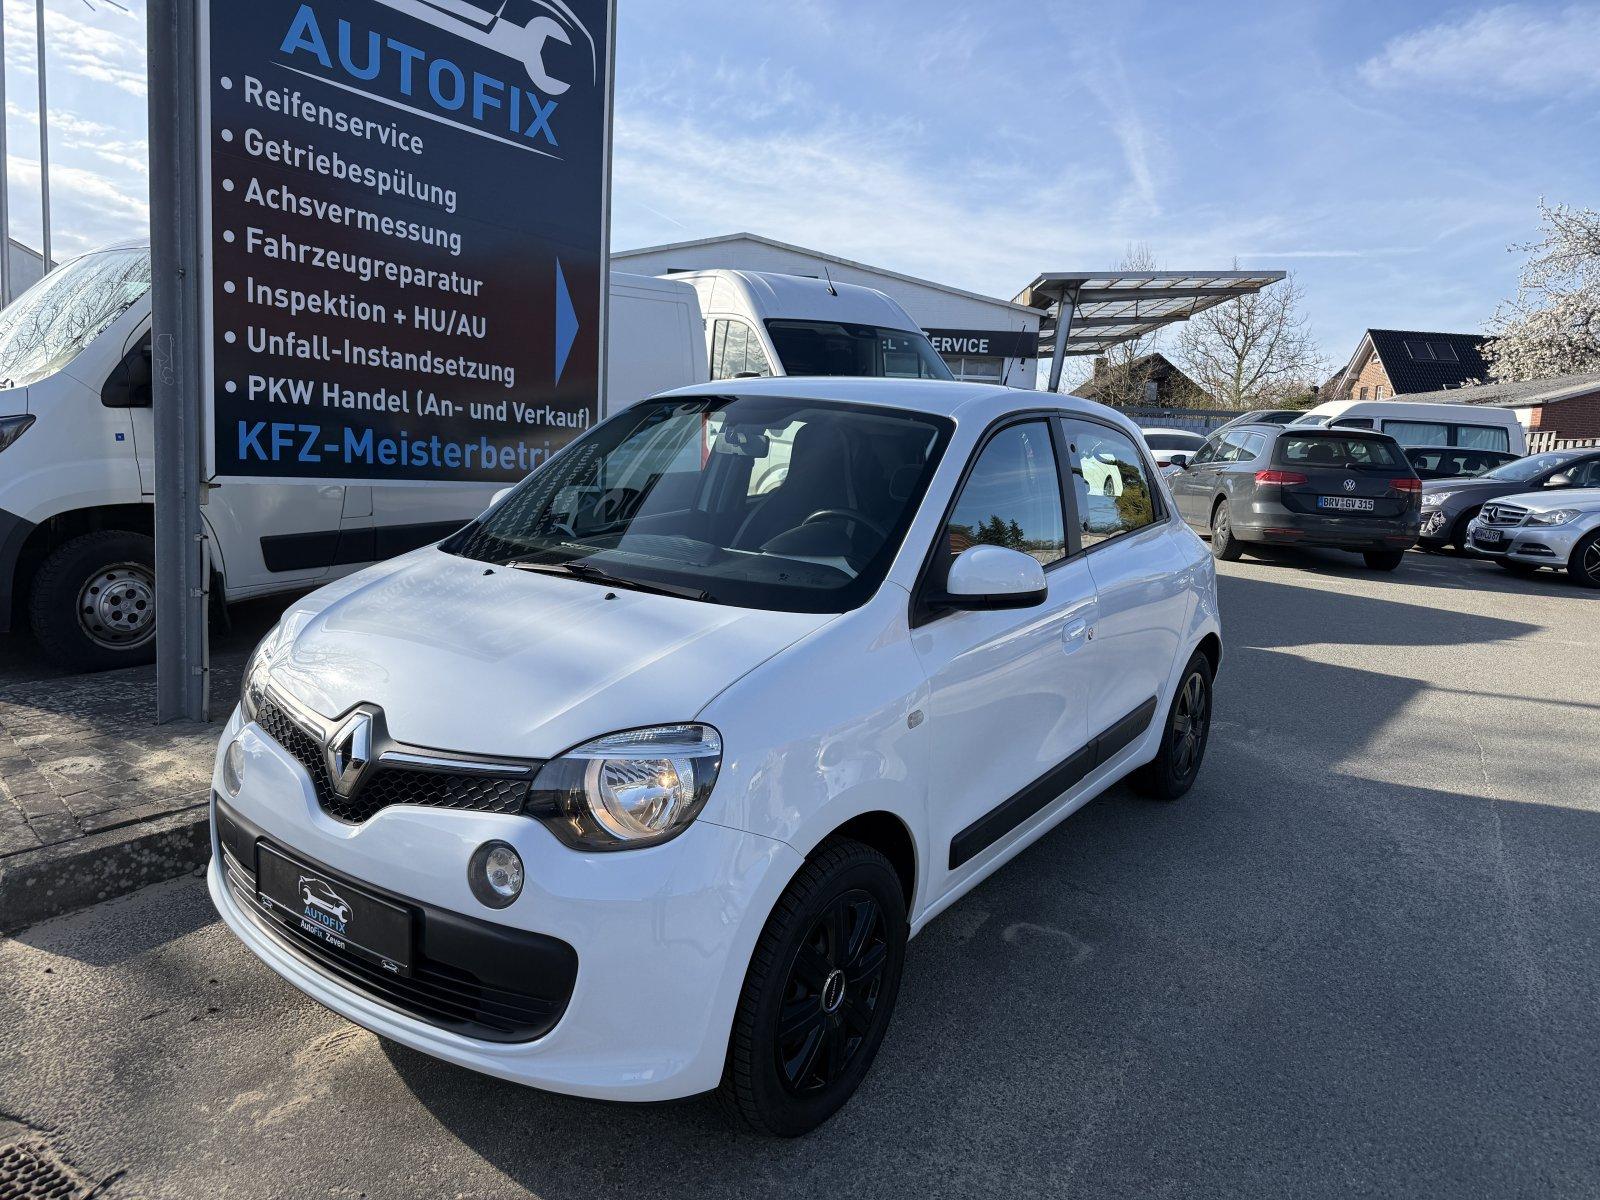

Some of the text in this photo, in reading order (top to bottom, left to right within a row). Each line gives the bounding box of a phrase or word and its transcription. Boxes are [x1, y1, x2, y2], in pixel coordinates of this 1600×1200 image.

[279, 3, 559, 147] AUTOFIX
[244, 75, 424, 155] Reifenservice
[244, 128, 457, 214] Getriebespülung
[244, 177, 462, 256] Achsvermessung
[246, 226, 483, 297] Fahrzeugreparatur
[247, 277, 487, 339] Inspektion + HU/AU
[247, 326, 515, 387] Unfall-Instandsetzung
[248, 375, 590, 431] PKW Handel (An- und Verkauf)
[238, 420, 559, 471] KFZ-Meisterbetri
[1323, 497, 1373, 510] BRV GV 315
[304, 905, 346, 933] AUTOFIX
[325, 932, 346, 949] Zeven
